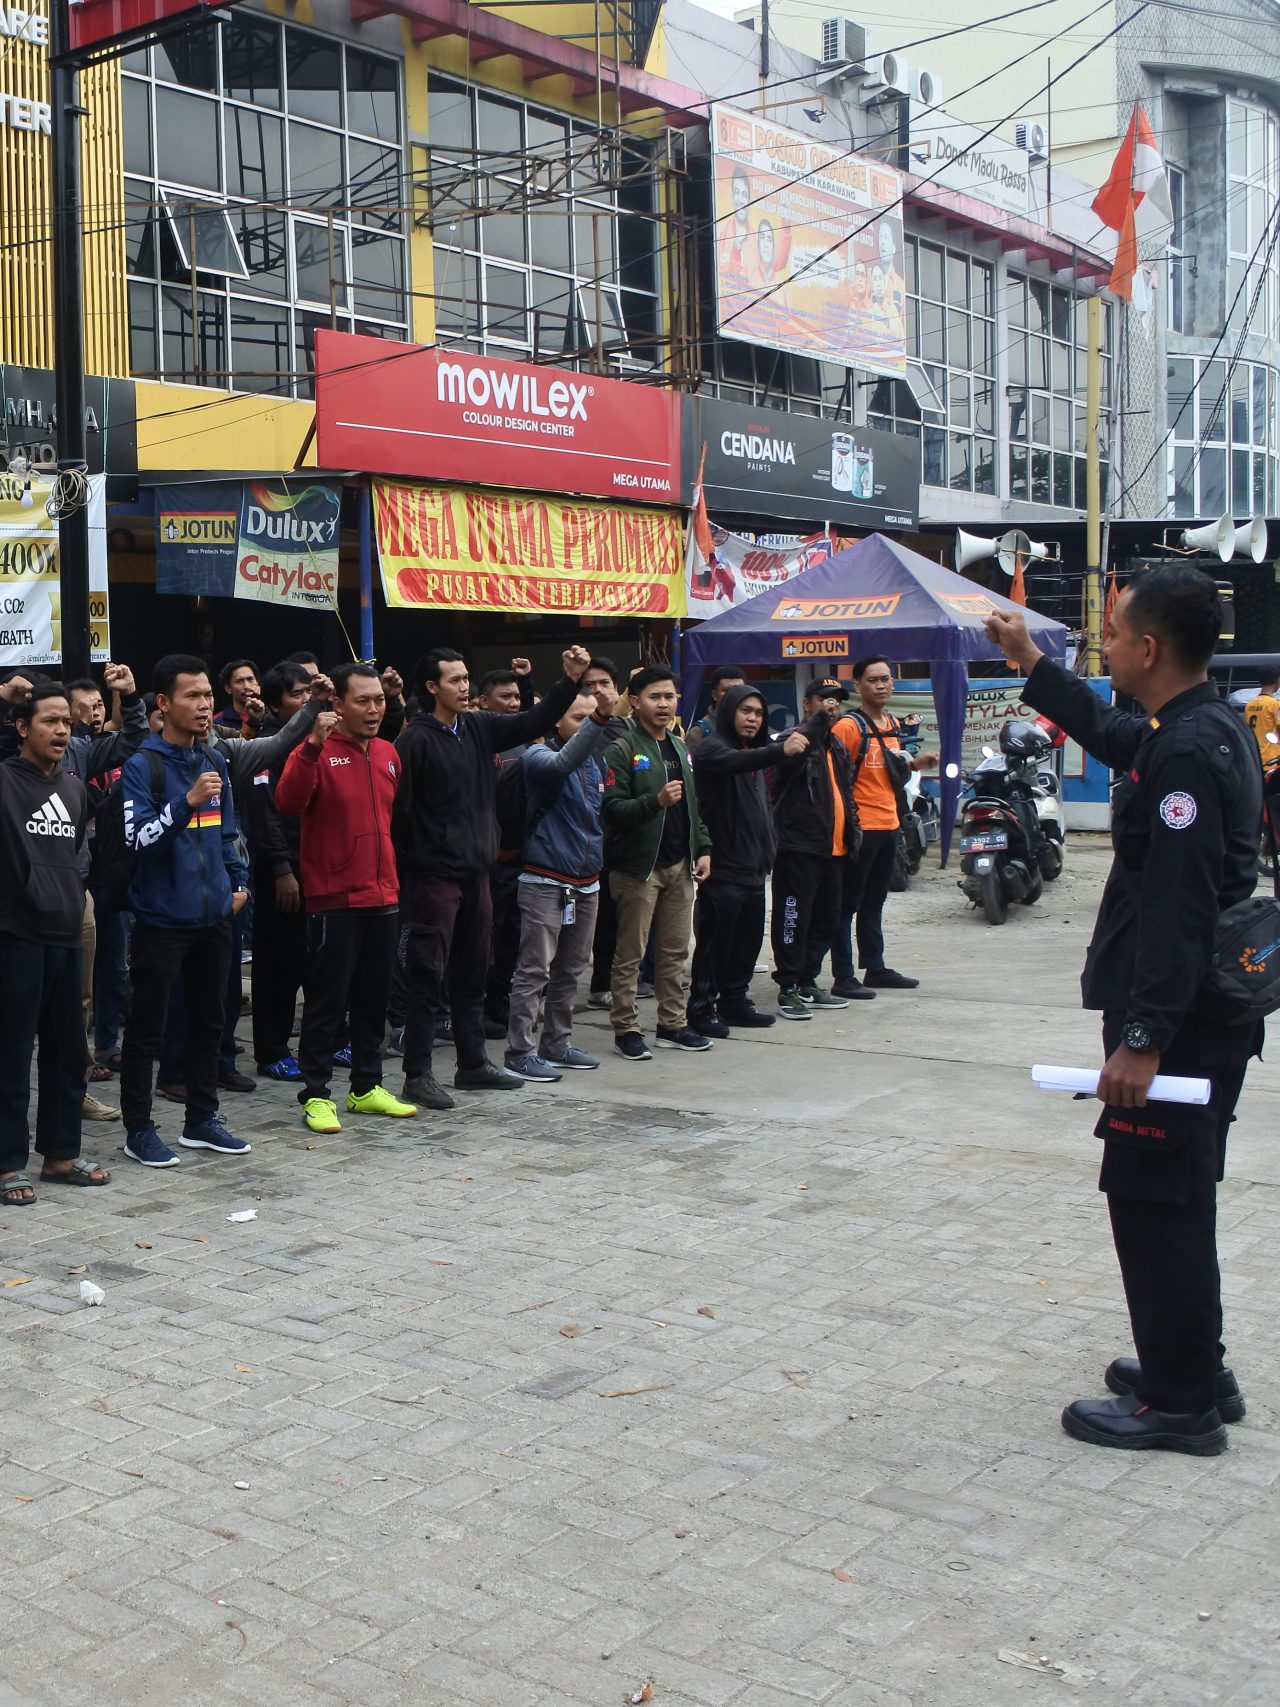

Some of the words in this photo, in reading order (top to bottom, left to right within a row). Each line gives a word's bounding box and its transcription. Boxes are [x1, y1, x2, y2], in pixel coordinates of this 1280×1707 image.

[754, 125, 807, 170] POSKO
[809, 145, 868, 192] ORANGE
[970, 151, 999, 180] Madu
[770, 161, 816, 188] KABUPATEN
[816, 176, 857, 202] KARAWANG
[462, 410, 503, 428] COLOUR
[504, 417, 539, 433] DESIGN
[540, 421, 575, 438] CENTER
[721, 430, 796, 465] CENDANA
[747, 461, 772, 473] PAINTS
[612, 472, 639, 487] MEGA
[640, 478, 671, 492] UTAMA
[180, 519, 236, 539] JOTUN
[246, 505, 325, 544] Dulux
[372, 483, 459, 561] MEGA
[464, 492, 556, 570] UTAMA
[560, 504, 680, 576] PERUMNAS
[884, 514, 897, 524] MEGA
[239, 554, 335, 596] Catylac
[426, 571, 490, 602] PUSAT
[497, 575, 530, 604] CAT
[536, 579, 652, 609] TERLENGKAP
[803, 599, 895, 618] JOTUN
[799, 639, 846, 655] JOTUN
[966, 703, 1032, 719] TYLAC
[25, 818, 77, 839] adidas
